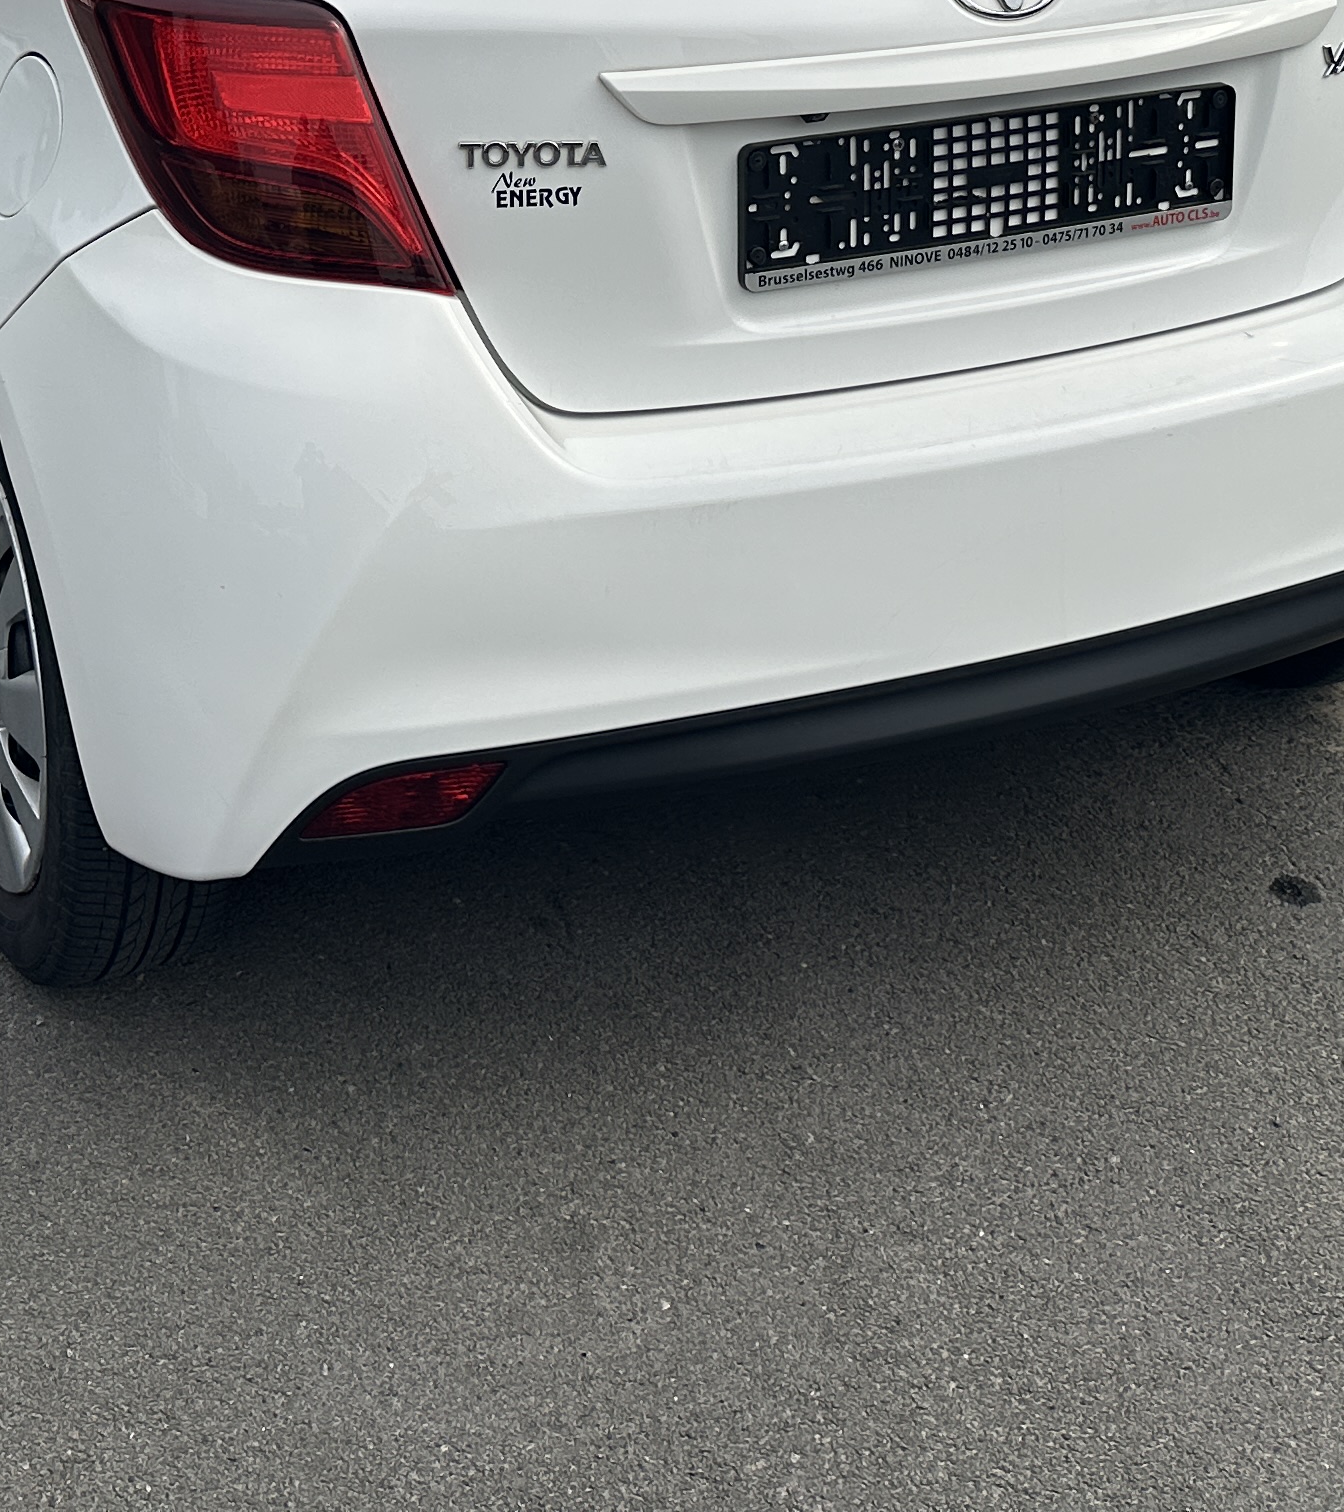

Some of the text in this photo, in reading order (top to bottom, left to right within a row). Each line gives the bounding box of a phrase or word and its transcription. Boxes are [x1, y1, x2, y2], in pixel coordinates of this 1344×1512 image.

[458, 140, 607, 169] TOYOTA
[491, 171, 536, 193] New
[496, 186, 583, 208] ENERGY
[758, 262, 855, 287] Brusselsestwg
[858, 260, 884, 274] 466
[889, 249, 942, 269] NINOVE
[947, 241, 999, 260] 0484/12
[1002, 239, 1017, 252] 25
[1020, 236, 1034, 249] 10
[1042, 228, 1089, 245] 0475/71
[1091, 224, 1106, 237] 70
[1108, 221, 1124, 235] 34
